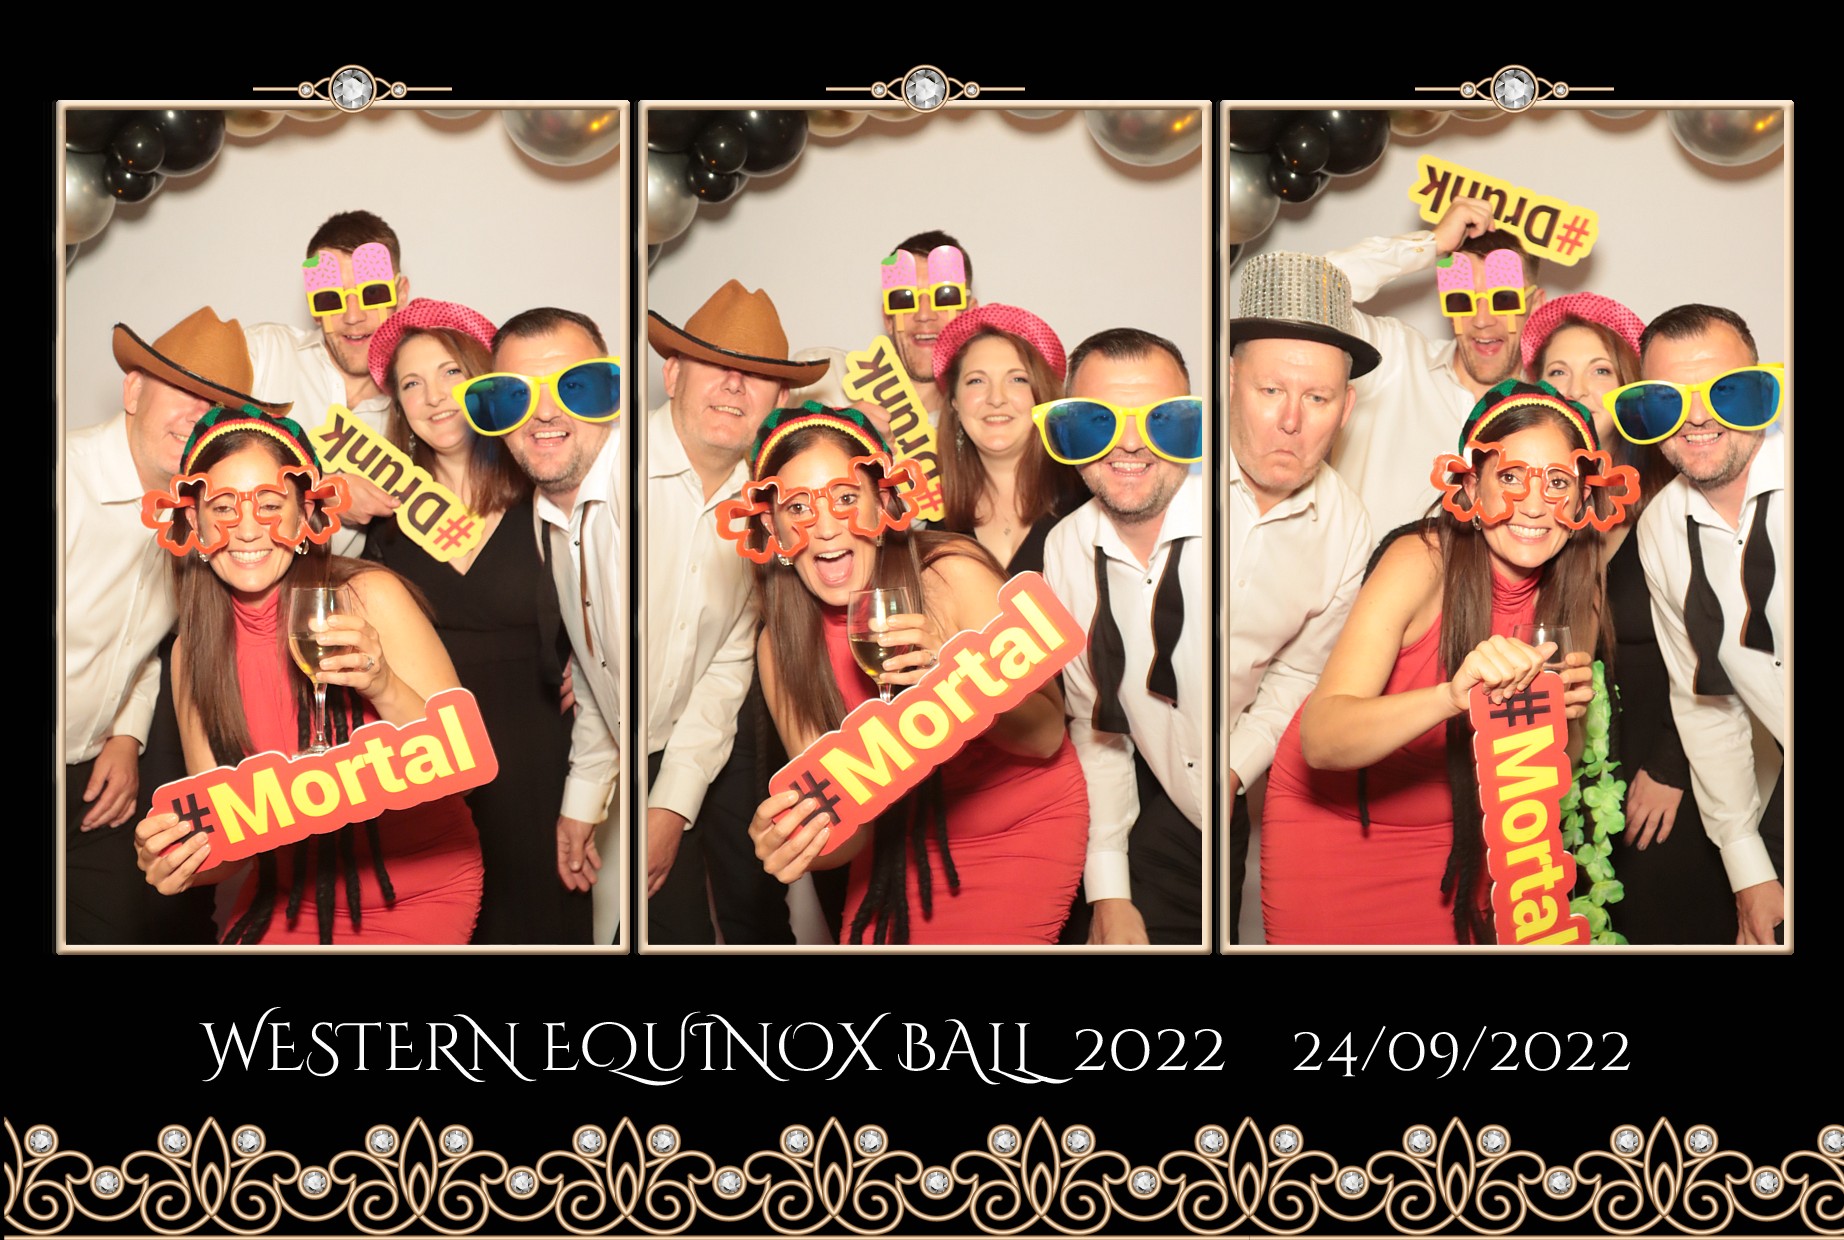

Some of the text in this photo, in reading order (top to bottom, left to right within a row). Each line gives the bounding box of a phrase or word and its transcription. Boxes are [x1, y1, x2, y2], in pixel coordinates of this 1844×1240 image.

[1418, 164, 1590, 256] #Drunk
[319, 412, 475, 551] #Drunk
[788, 590, 1064, 826] #Mortal
